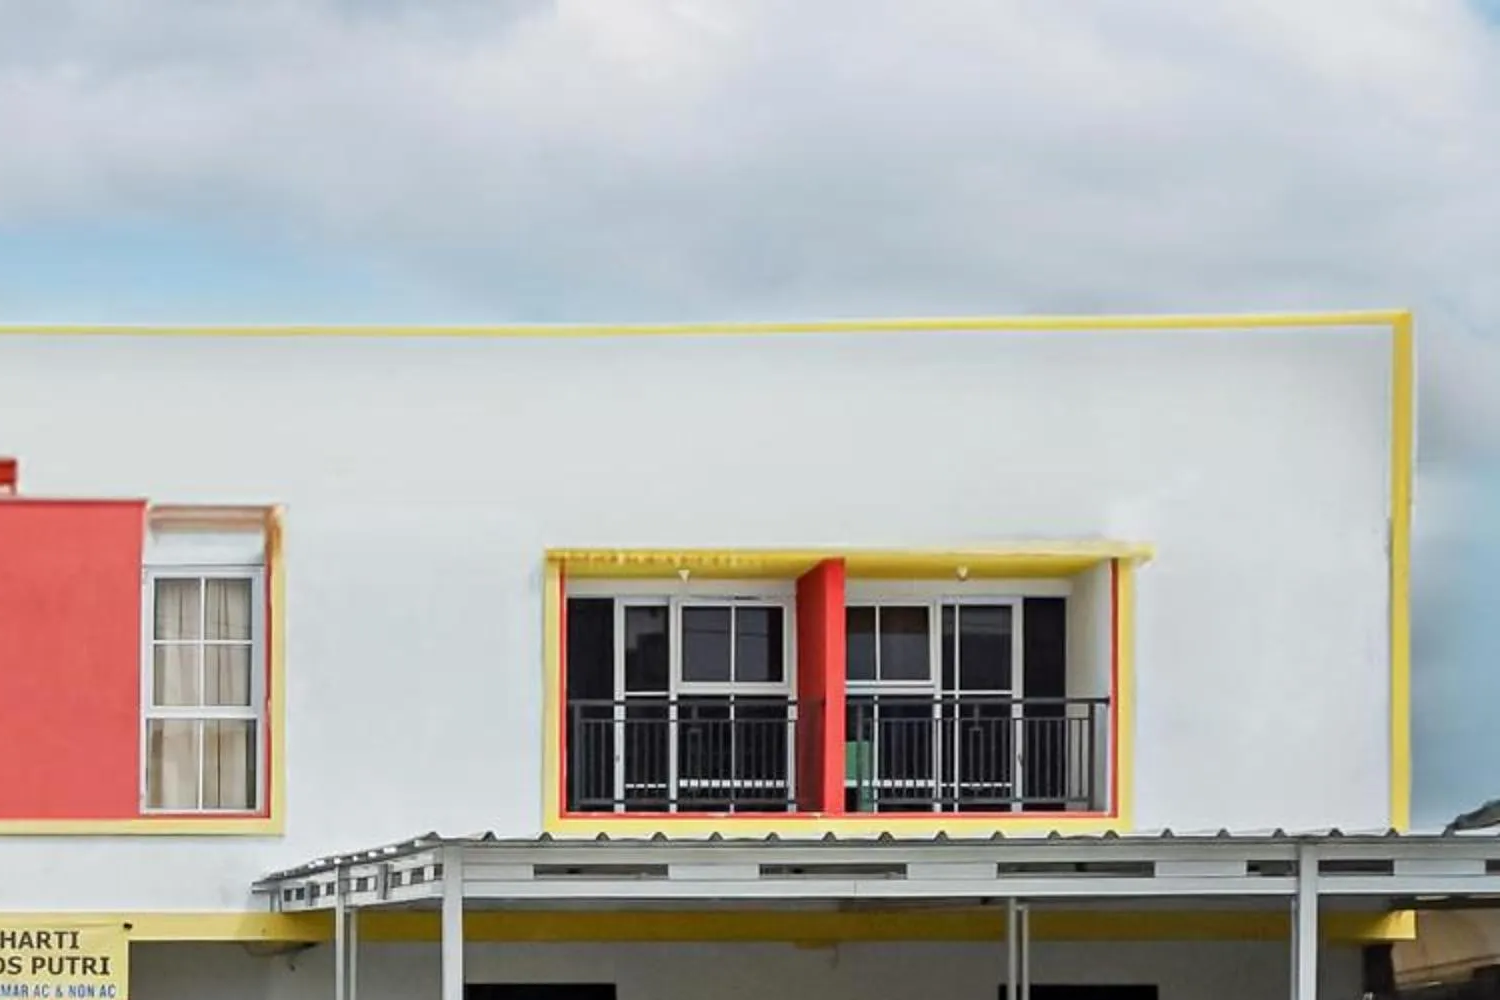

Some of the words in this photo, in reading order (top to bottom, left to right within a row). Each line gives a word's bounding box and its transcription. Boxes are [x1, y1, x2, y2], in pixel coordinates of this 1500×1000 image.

[30, 956, 111, 975] PUTRI
[33, 984, 51, 999] AC
[68, 984, 96, 999] NON
[99, 984, 117, 999] AC
